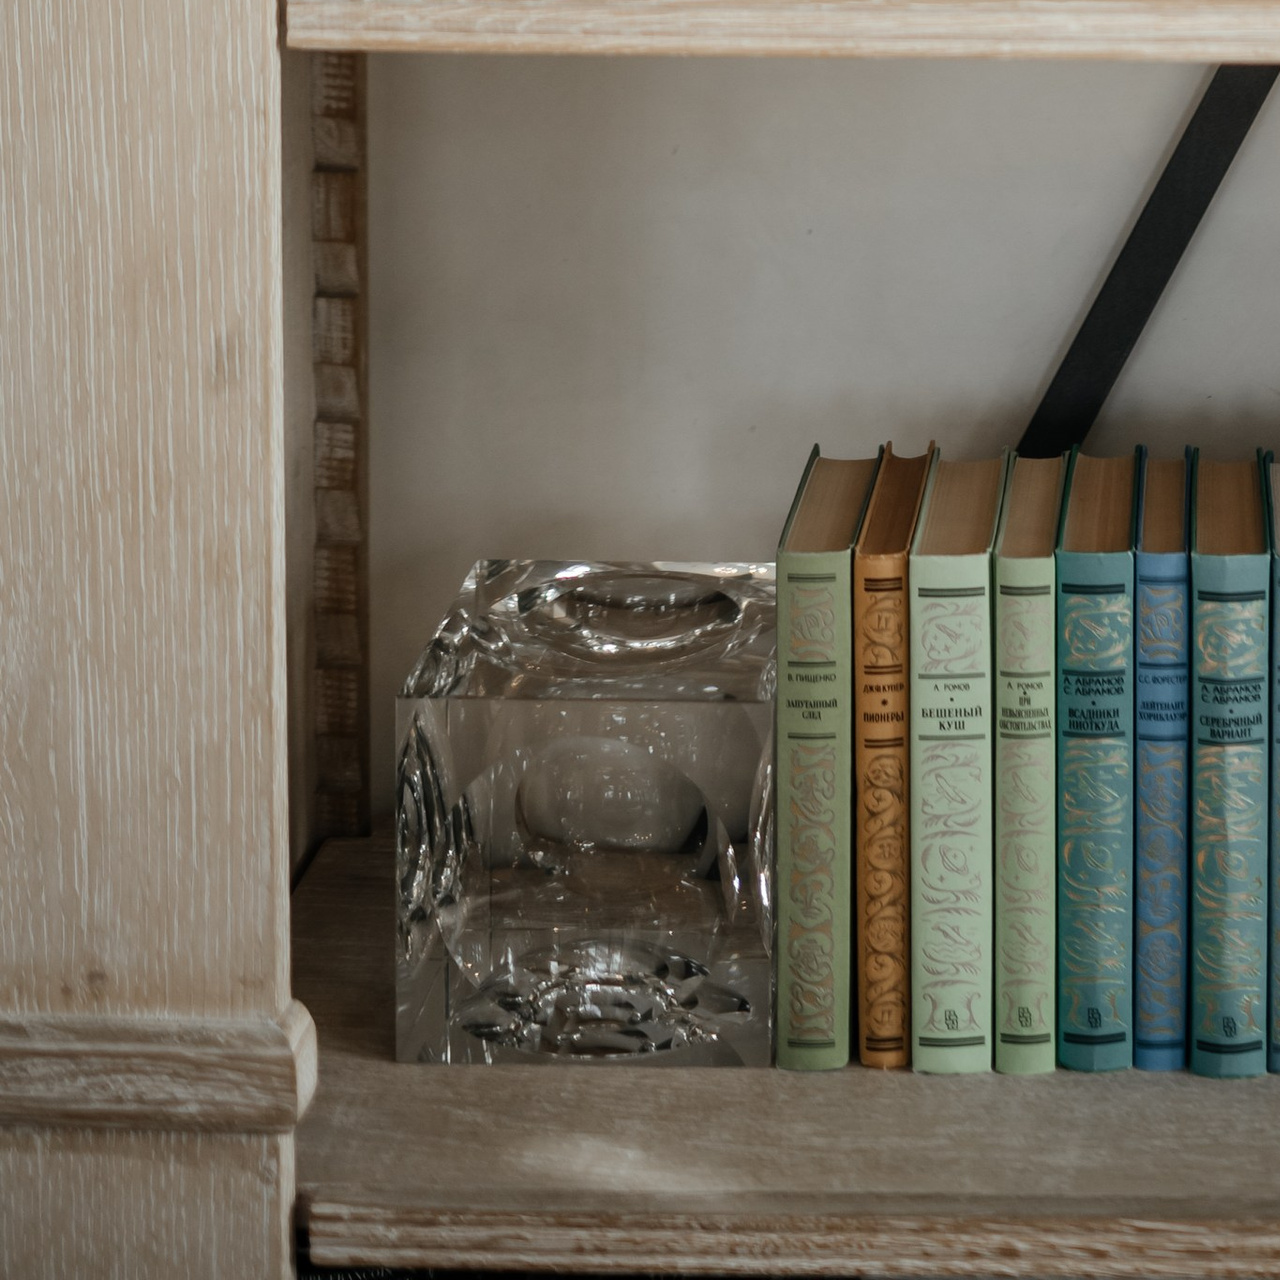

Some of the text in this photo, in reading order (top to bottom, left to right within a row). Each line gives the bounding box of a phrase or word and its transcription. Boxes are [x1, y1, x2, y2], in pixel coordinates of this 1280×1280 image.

[796, 673, 836, 683] ПИЩЕНКО
[786, 698, 838, 709] ЗАПУТАННЫЙ
[1019, 696, 1031, 706] ПРИ
[1141, 700, 1185, 711] ЛЕЙТЕНАНТ
[802, 710, 822, 721] СЛЕД
[921, 704, 983, 718] БЕШЕНЫЙ
[1068, 708, 1119, 719] ВСАДНИКИ
[863, 711, 904, 723] ПИОНЕРЫ
[1200, 713, 1263, 727] СЕРЕБРЯНЫЙ
[939, 721, 965, 730] КУШ
[1069, 719, 1120, 731] НИОТКУДА
[1210, 727, 1253, 739] ВАРИАНТ
